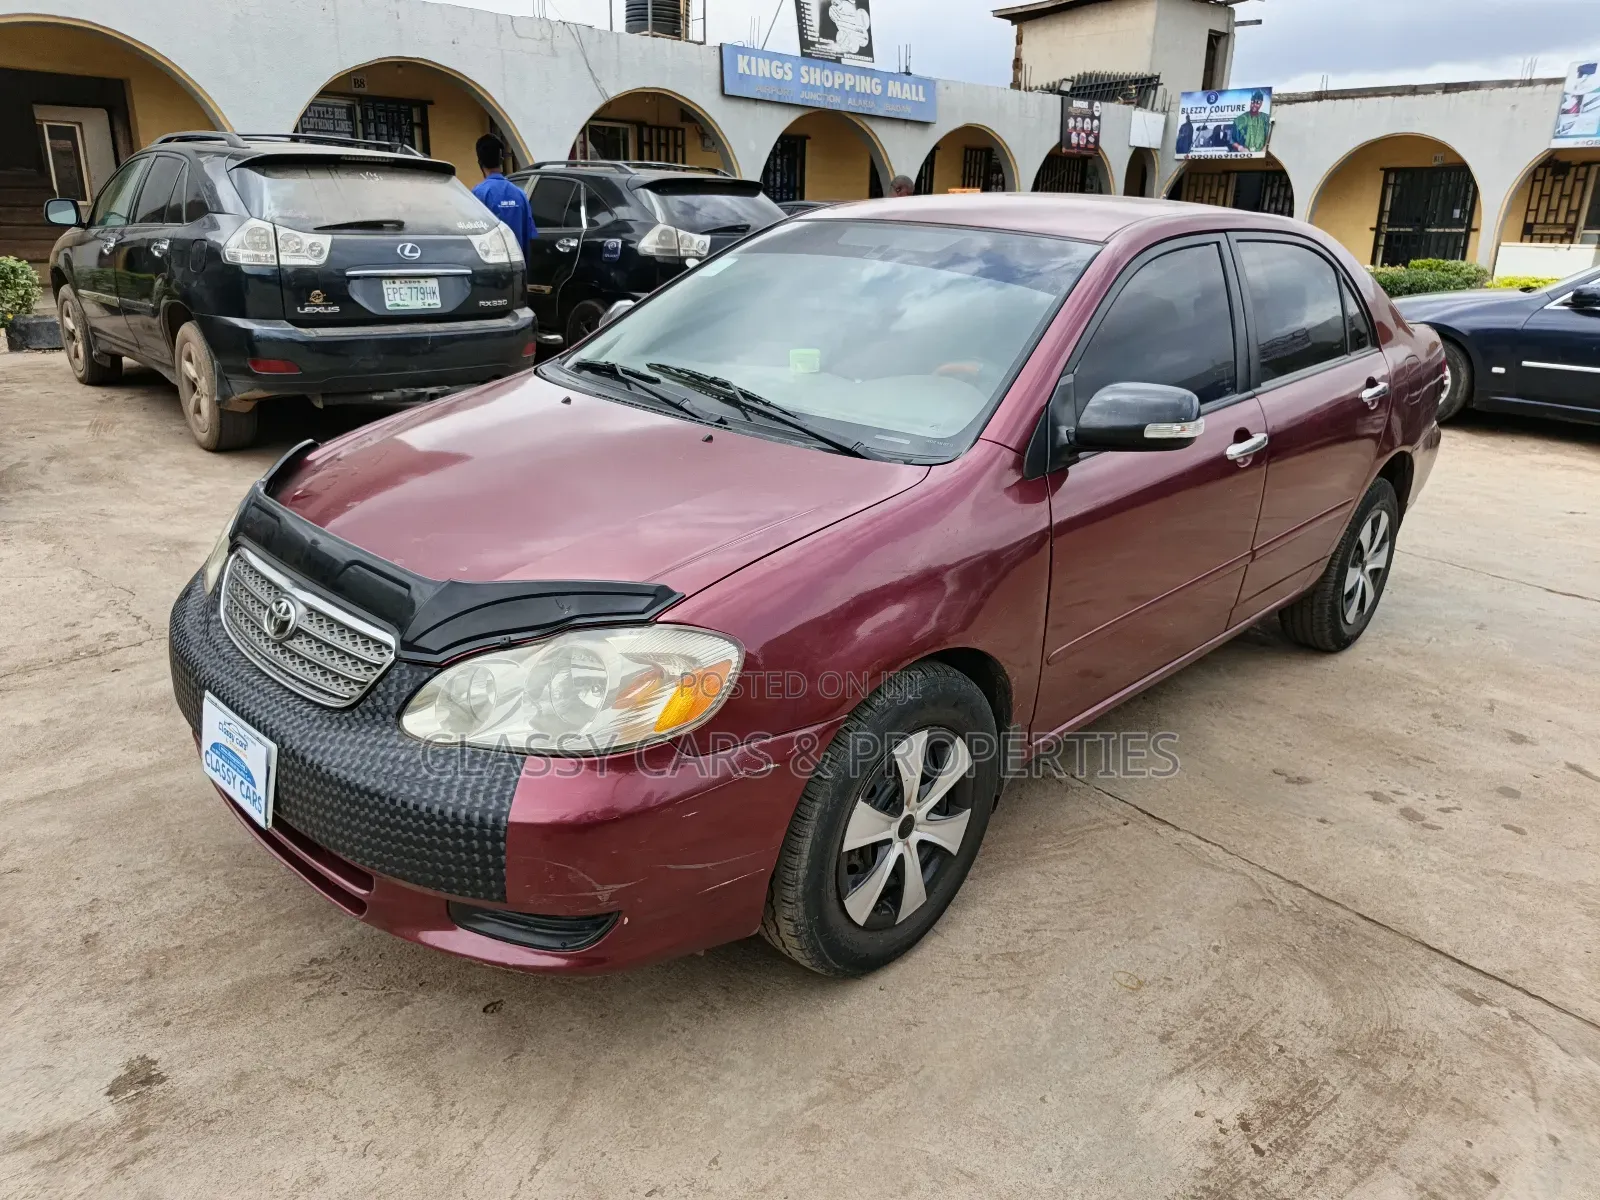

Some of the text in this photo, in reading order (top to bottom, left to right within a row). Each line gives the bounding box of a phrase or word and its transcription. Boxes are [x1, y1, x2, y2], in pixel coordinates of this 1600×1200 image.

[353, 78, 366, 89] B8
[737, 54, 926, 102] KINGS SHOPPING MALL
[755, 85, 794, 97] AIRPORT
[799, 90, 841, 104] JUNCTION
[306, 106, 347, 120] LITTLE BIG
[1181, 104, 1246, 115] BLEZZY COUTURE
[302, 118, 334, 131] CLOTHING
[297, 306, 340, 314] LEXUS
[204, 750, 263, 815] CLASSY CARS
